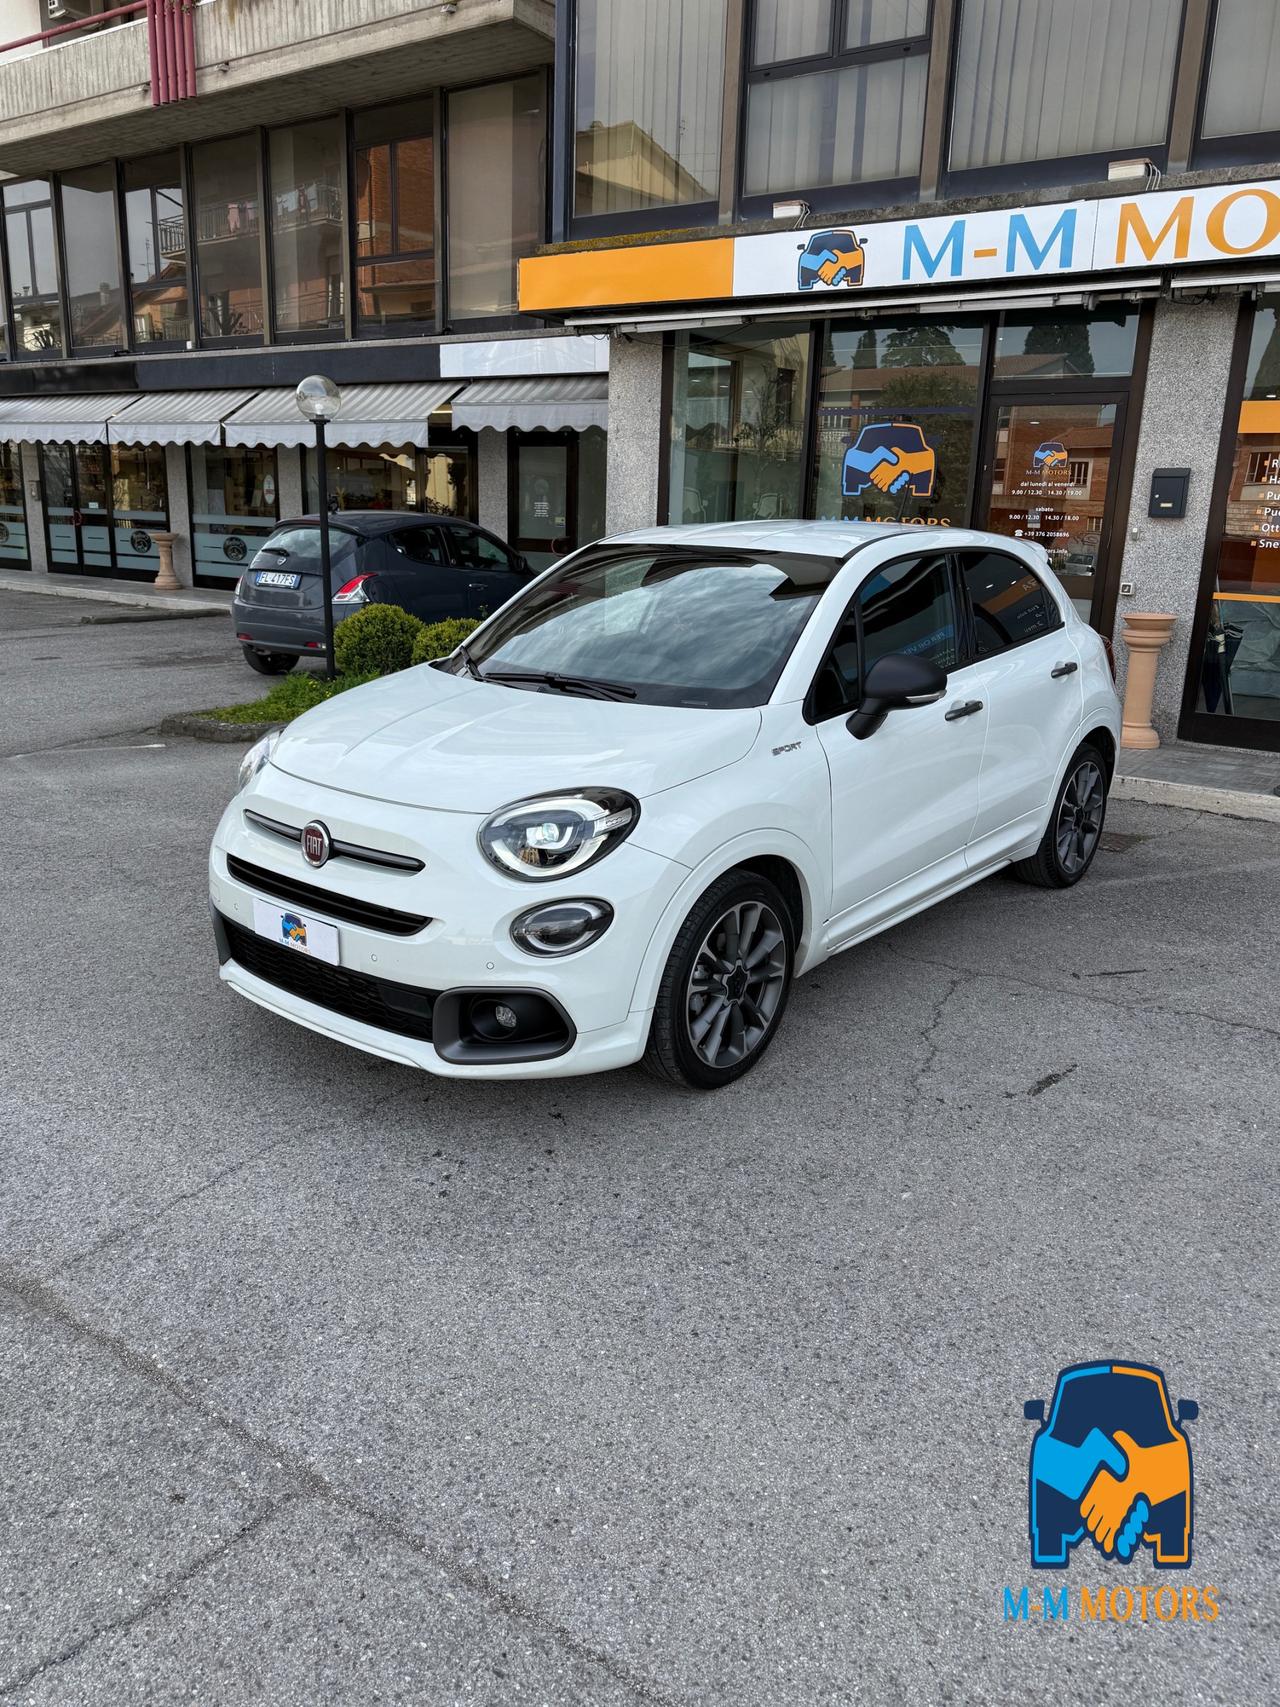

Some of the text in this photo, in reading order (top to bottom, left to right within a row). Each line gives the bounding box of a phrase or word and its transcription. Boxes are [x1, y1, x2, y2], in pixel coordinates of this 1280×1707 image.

[902, 188, 1280, 281] M-M MO
[772, 741, 802, 756] SPORT
[306, 834, 323, 856] FIAT
